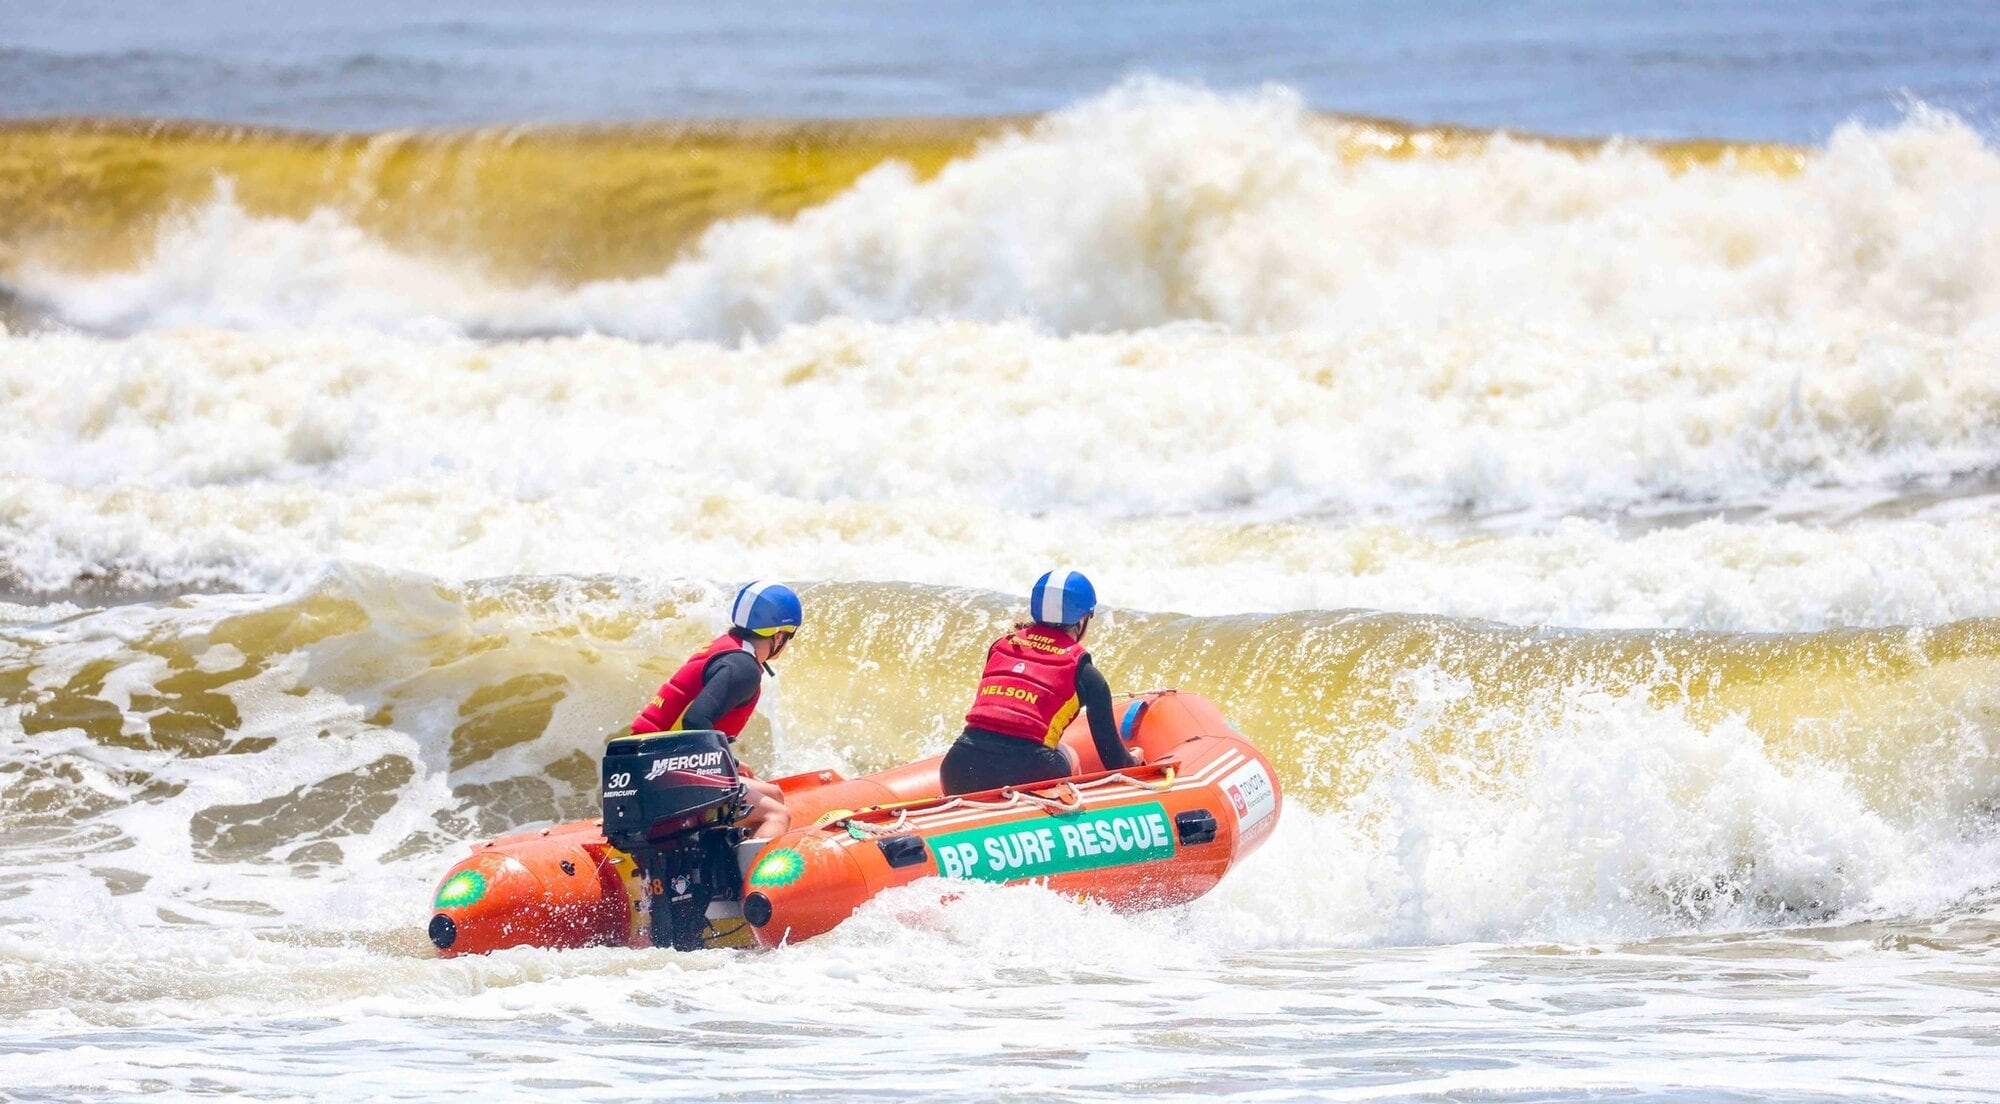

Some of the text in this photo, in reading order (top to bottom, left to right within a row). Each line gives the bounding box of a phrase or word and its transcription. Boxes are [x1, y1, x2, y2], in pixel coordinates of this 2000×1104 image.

[1027, 634, 1056, 644] SURF
[980, 685, 1038, 704] NELSON
[644, 751, 722, 780] MERCURY
[696, 767, 722, 776] Rescue
[608, 772, 631, 789] 30
[1240, 773, 1265, 796] TOYOTA
[603, 789, 637, 798] MERCURY
[938, 813, 1168, 879] BP SURF RESCUE
